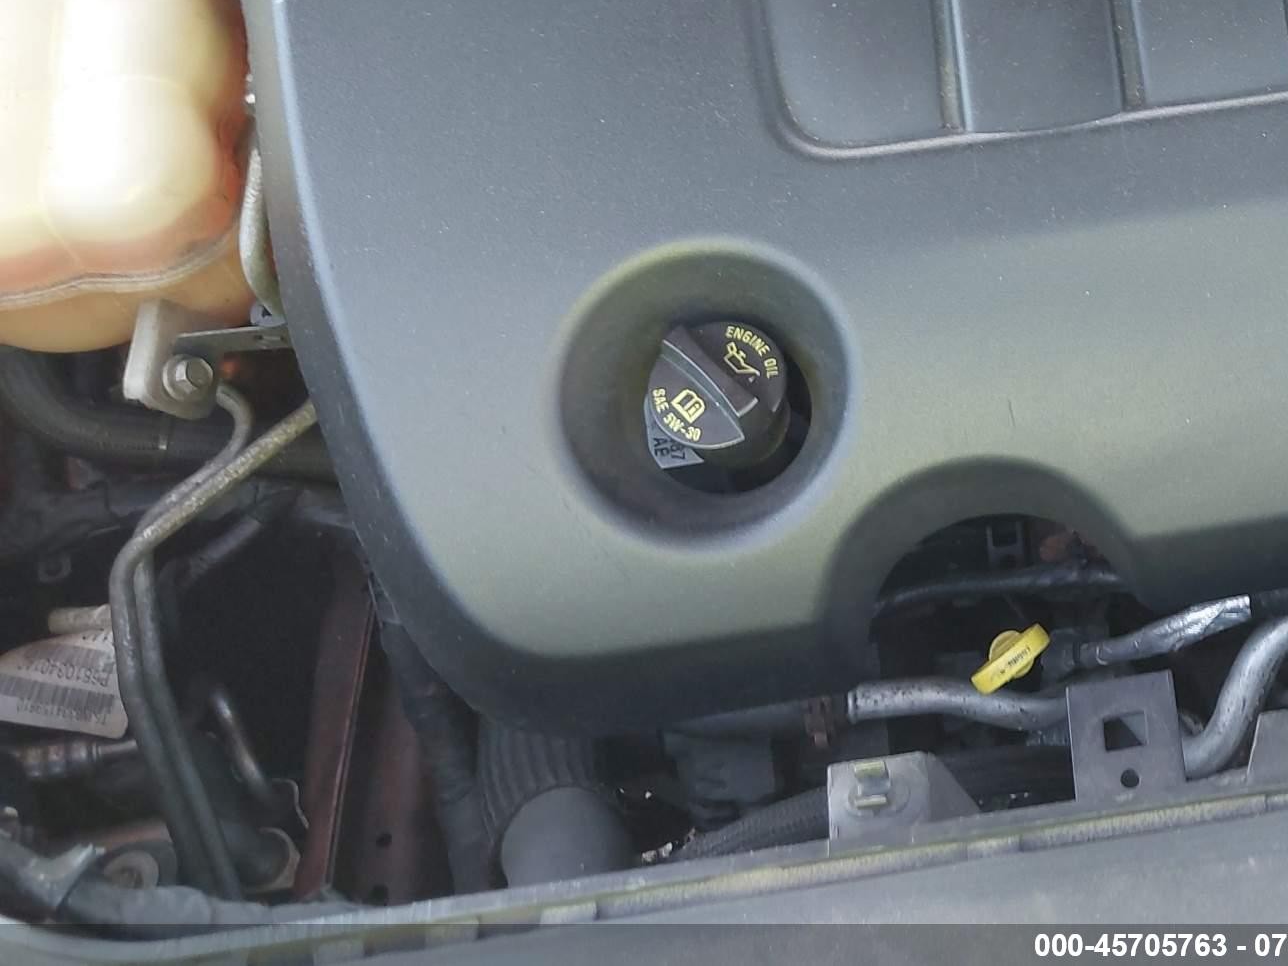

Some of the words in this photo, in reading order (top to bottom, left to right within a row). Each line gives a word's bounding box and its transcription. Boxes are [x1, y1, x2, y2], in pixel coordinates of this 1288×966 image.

[725, 325, 771, 357] ENGINE
[763, 357, 779, 379] OIL
[652, 387, 670, 413] SAE
[662, 412, 702, 442] 5W-30
